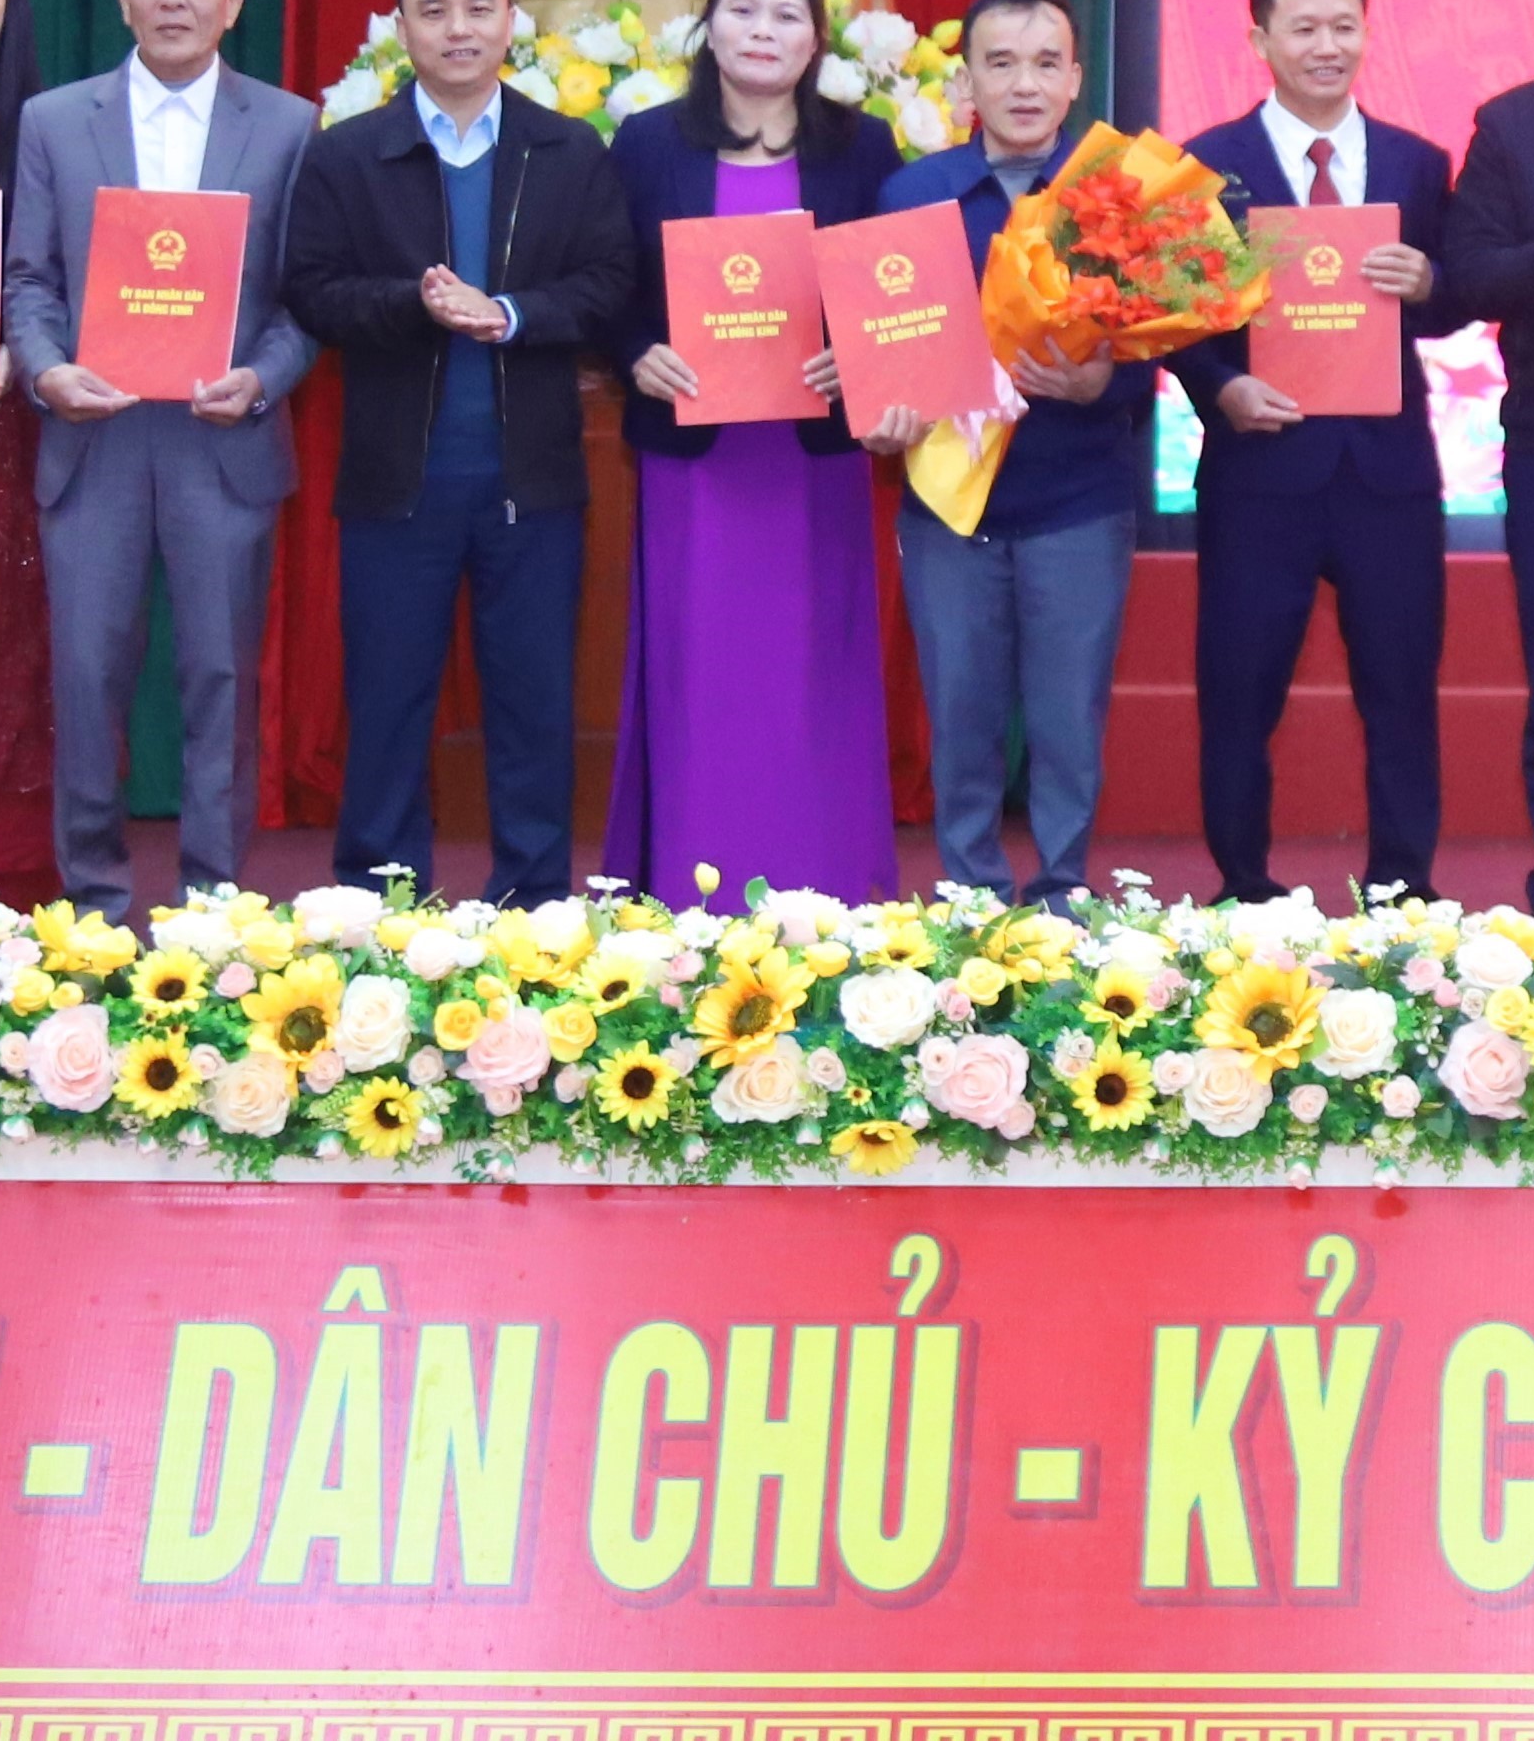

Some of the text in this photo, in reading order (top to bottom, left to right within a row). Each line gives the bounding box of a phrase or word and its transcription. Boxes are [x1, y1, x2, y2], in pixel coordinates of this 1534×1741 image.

[23, 1444, 92, 1496] -
[140, 1264, 541, 1586] DÂN
[588, 1233, 963, 1591] CHỦ
[1014, 1448, 1081, 1501] -
[1142, 1233, 1381, 1588] KỶ
